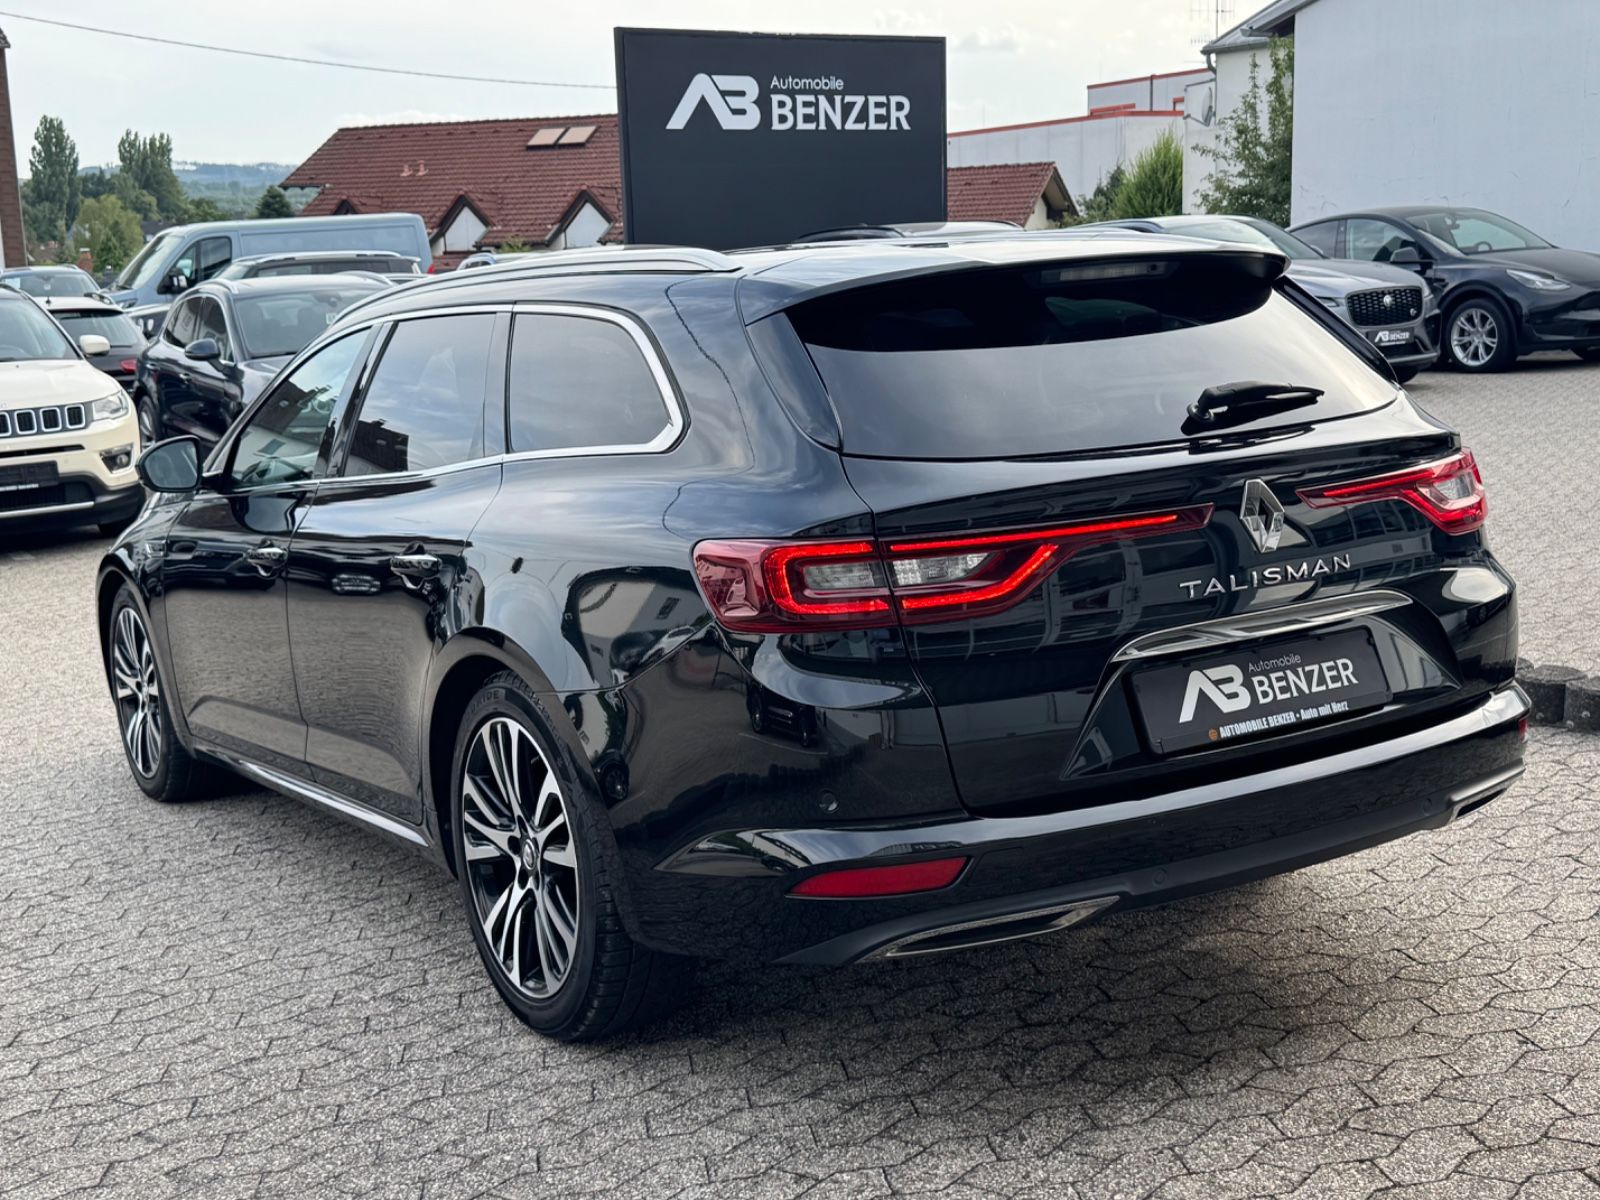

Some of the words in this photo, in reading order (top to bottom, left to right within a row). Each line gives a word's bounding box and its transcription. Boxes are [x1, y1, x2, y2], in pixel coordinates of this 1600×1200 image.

[770, 75, 844, 91] Automobile
[770, 93, 911, 130] BENZER
[1179, 553, 1352, 599] TALISMAN
[1248, 653, 1302, 673] Automobile
[1251, 657, 1359, 705] BENZER
[1219, 717, 1269, 738] AUTOMOBILE
[1269, 711, 1297, 727] BENZER
[1300, 707, 1319, 720] Auto
[1319, 703, 1333, 716] mit
[1332, 701, 1349, 713] Herz
